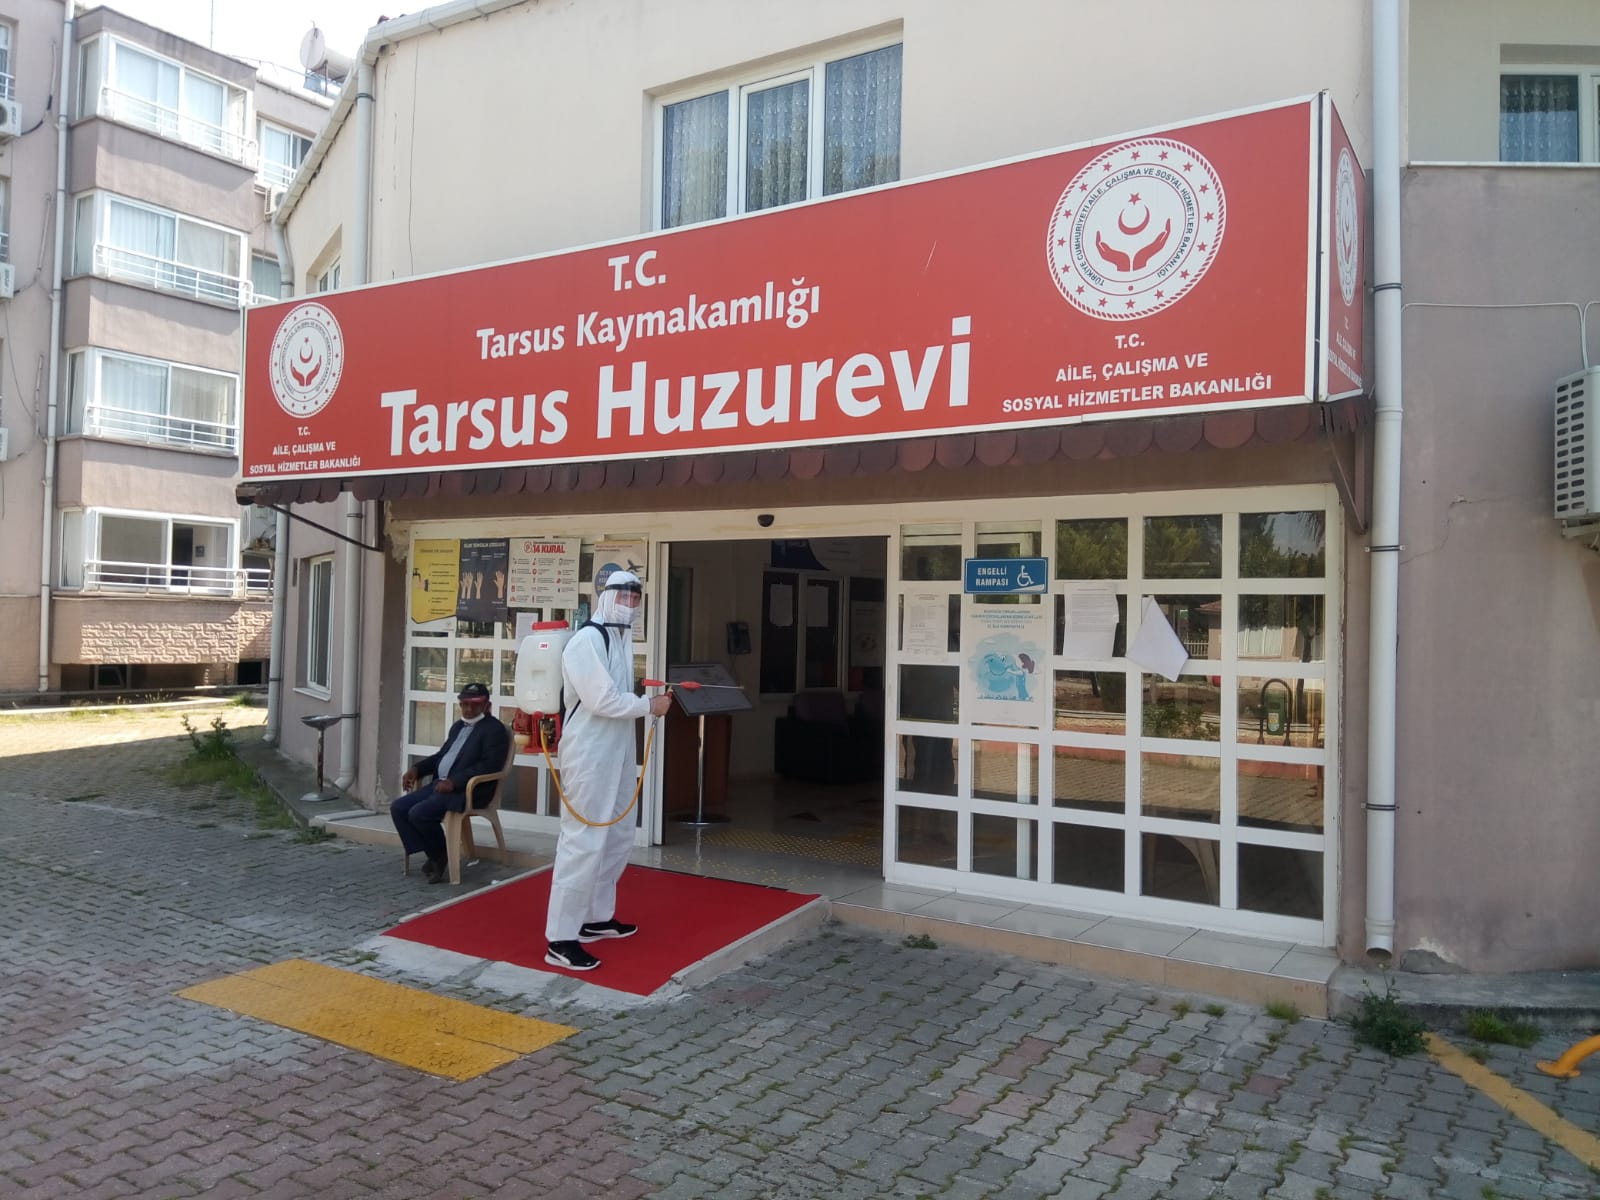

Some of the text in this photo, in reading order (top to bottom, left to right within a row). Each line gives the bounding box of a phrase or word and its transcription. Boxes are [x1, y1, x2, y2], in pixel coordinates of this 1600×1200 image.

[1105, 167, 1141, 188] ÇALIŞMA
[1143, 168, 1154, 176] VE
[1155, 169, 1182, 190] SOSYAL
[1181, 188, 1195, 234] HİZMETLER
[608, 251, 666, 291] T.C.
[477, 276, 820, 359] Tarsus Kaymakamlığı
[1114, 333, 1145, 349] T.C.
[1056, 353, 1208, 383] AİLE, ÇALIŞMA VE
[381, 315, 972, 456] Tarsus Huzurevi
[1002, 373, 1272, 413] SOSYAL HİZMETLER BAKANLIĞI
[297, 426, 311, 436] T.C.
[272, 441, 336, 456] AİLE, ÇALIŞMA VE
[249, 455, 361, 475] SOSYAL HİZMETLER BAKANLIĞI
[532, 544, 566, 554] 14 KURAL
[977, 565, 1007, 576] ENGELLİ
[975, 578, 1009, 586] RAMPASI
